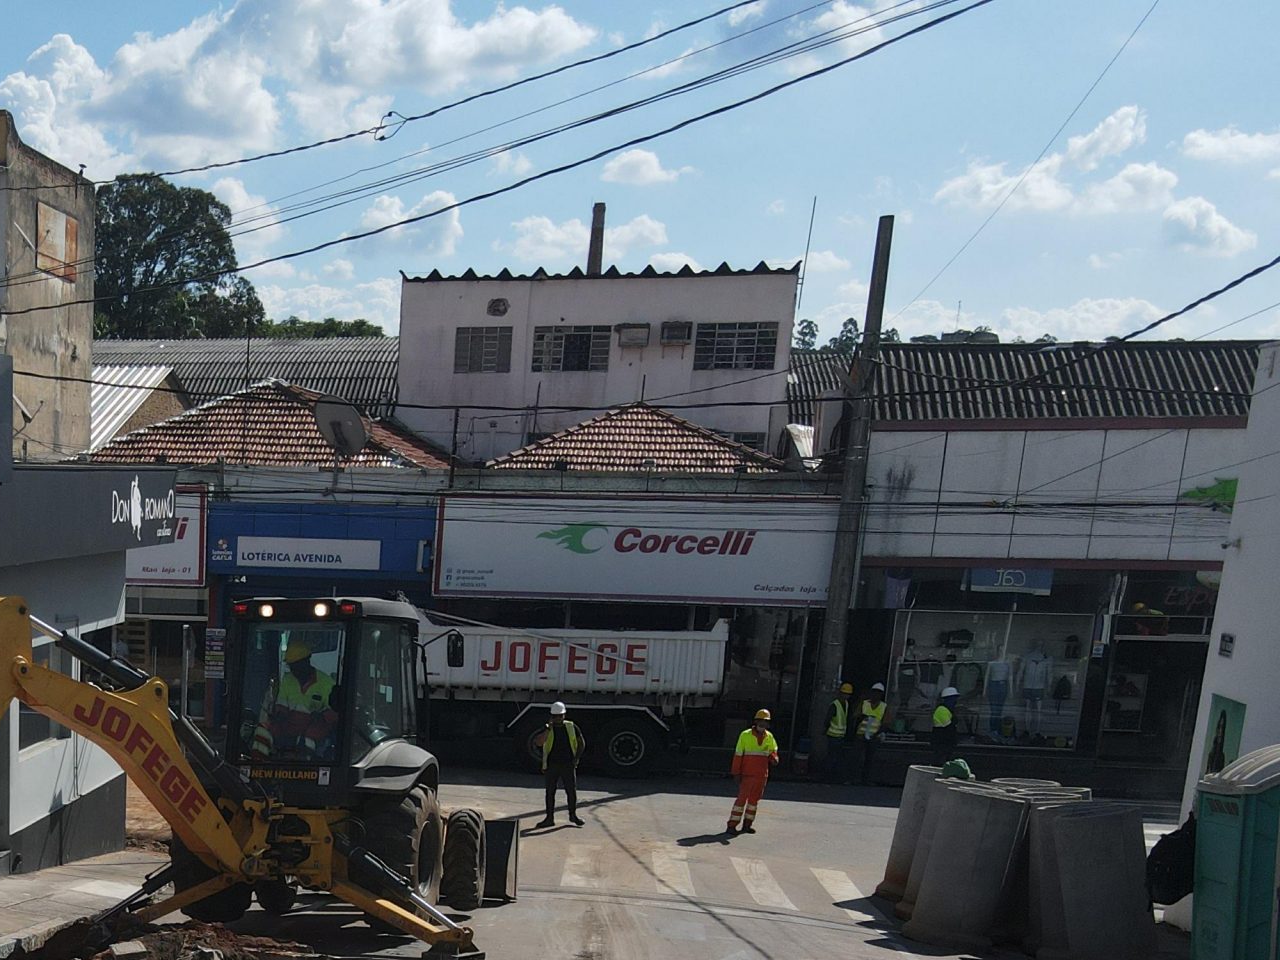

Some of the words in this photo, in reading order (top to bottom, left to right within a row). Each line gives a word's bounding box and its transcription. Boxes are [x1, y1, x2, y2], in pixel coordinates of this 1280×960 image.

[614, 527, 758, 556] Corcelli
[241, 550, 291, 563] LOTÉRICA
[293, 553, 343, 564] AVENIDA
[753, 584, 795, 592] Calçados
[481, 640, 648, 676] JOFEGE
[73, 696, 208, 825] JOFEGE
[251, 769, 273, 778] NEW
[275, 770, 318, 779] HOLLAND
